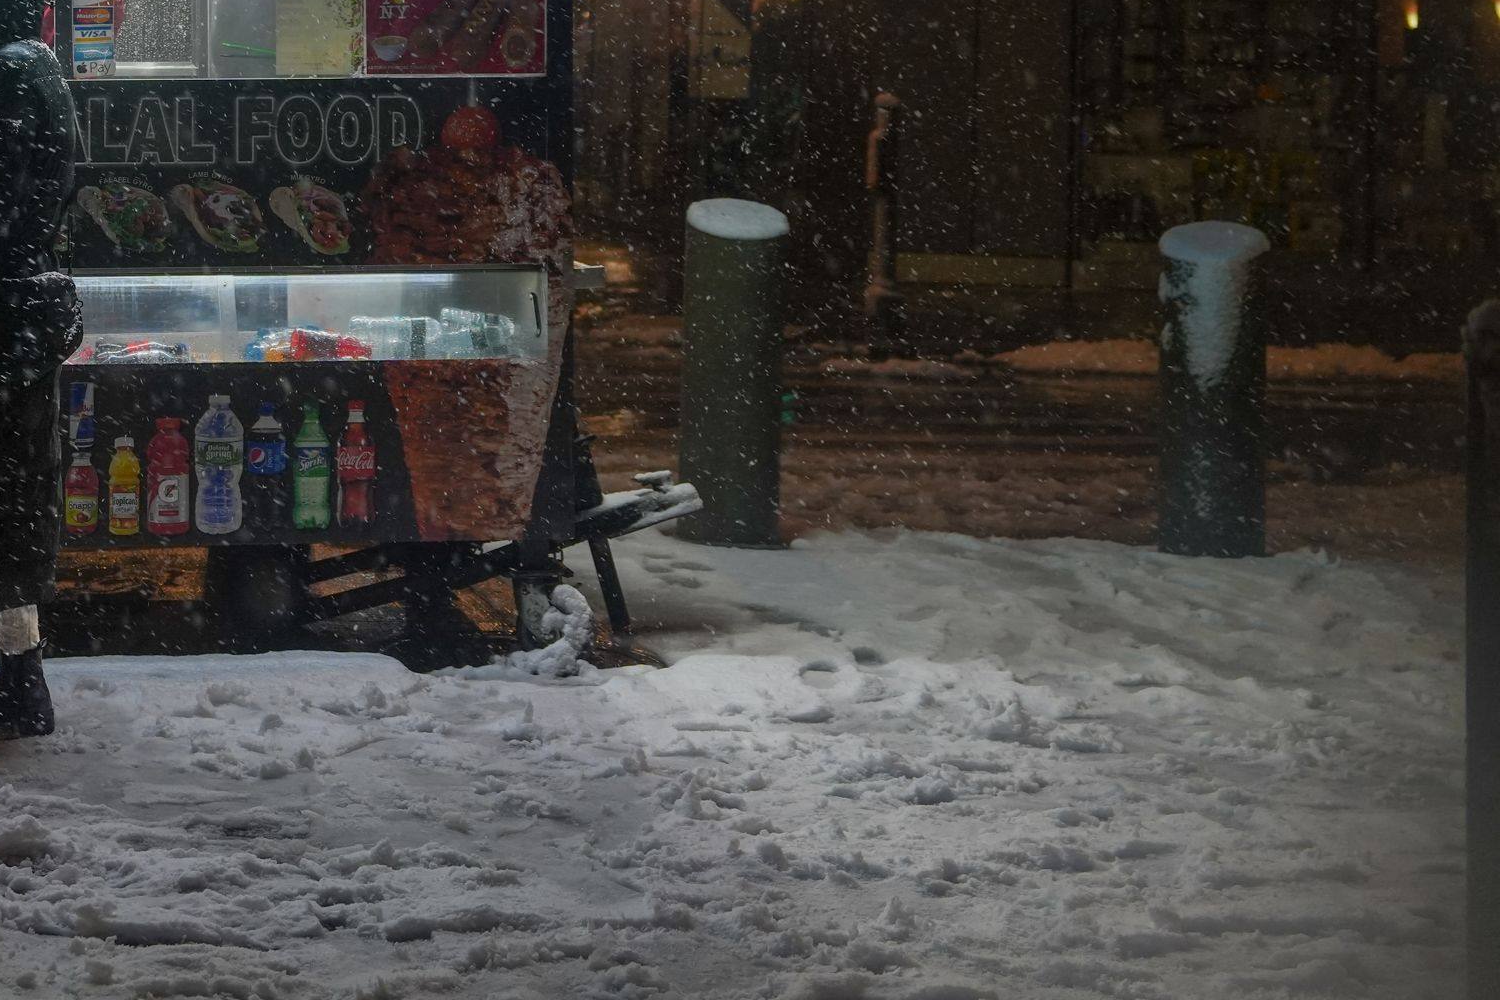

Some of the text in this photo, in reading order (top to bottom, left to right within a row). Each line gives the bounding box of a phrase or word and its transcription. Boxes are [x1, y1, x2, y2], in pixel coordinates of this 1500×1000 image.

[379, 5, 411, 19] NY
[90, 62, 112, 75] Pay
[73, 97, 216, 165] LAL
[235, 95, 422, 165] FOOD
[188, 171, 209, 179] LAMB
[132, 177, 154, 191] GYRO
[300, 455, 325, 473] Sprite
